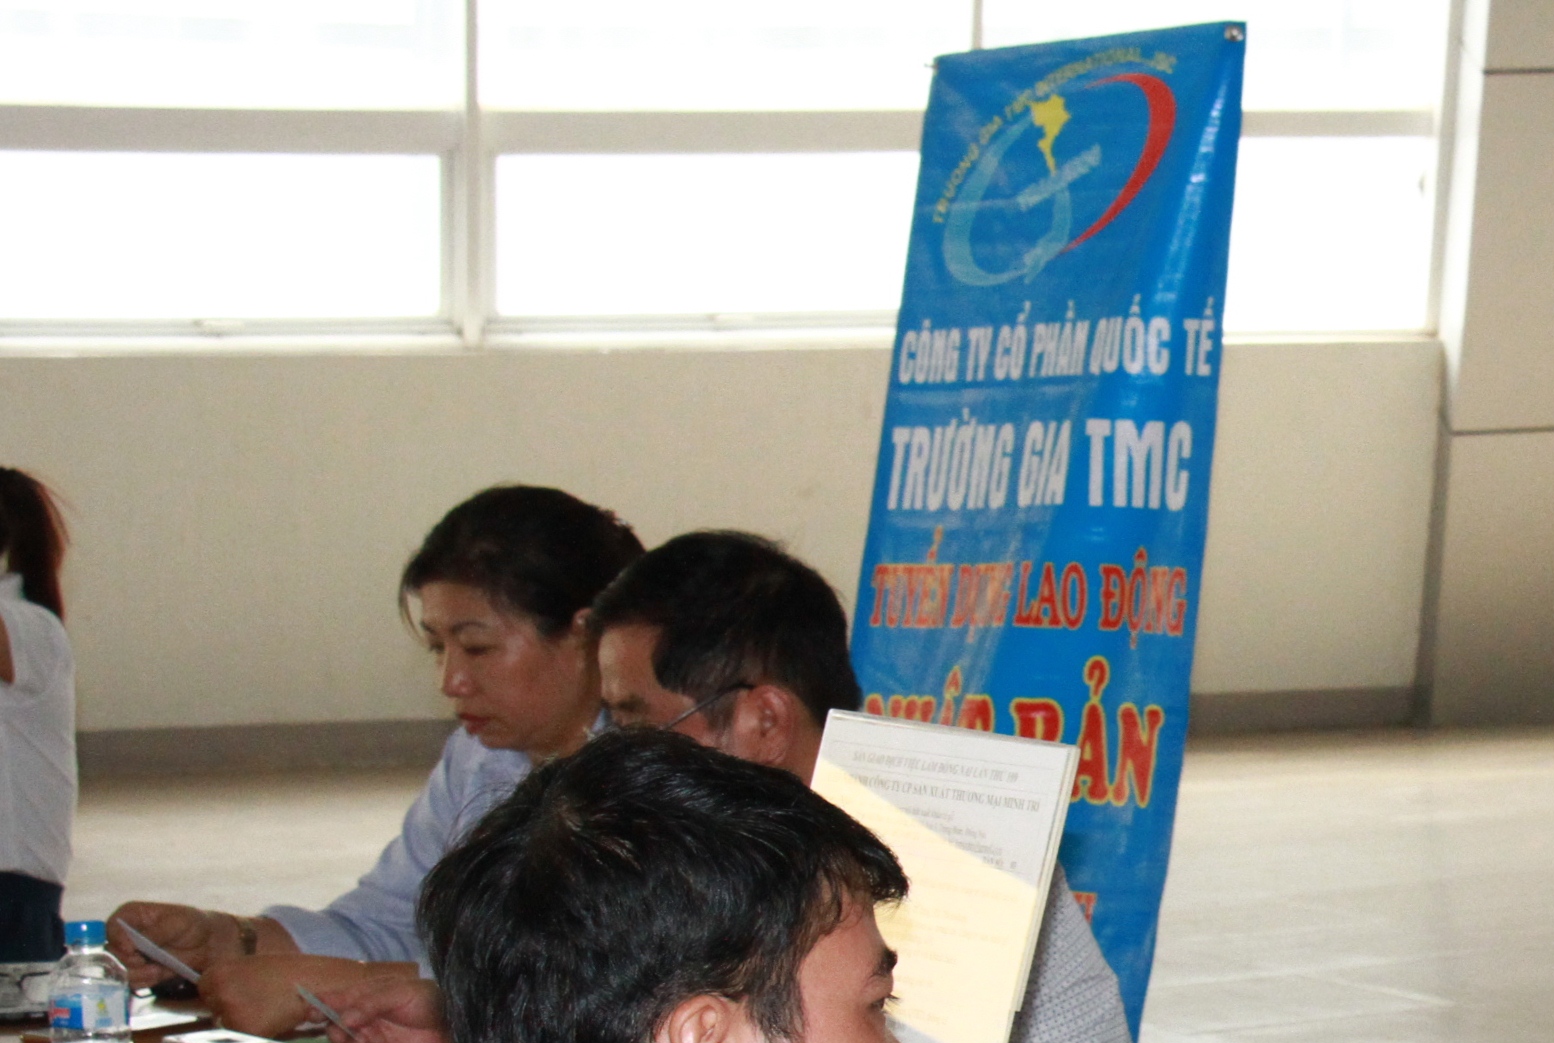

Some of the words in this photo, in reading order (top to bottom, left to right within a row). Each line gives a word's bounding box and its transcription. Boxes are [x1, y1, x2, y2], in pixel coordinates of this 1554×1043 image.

[898, 319, 961, 385] CÔNG
[966, 326, 993, 382] TY
[1089, 294, 1171, 376] QUỐC
[888, 408, 1016, 512] TRƯỜNG
[1017, 420, 1073, 509] GIA
[1085, 419, 1194, 513] TMC
[1012, 562, 1088, 630] LAO
[1099, 546, 1189, 648] ĐỘNG
